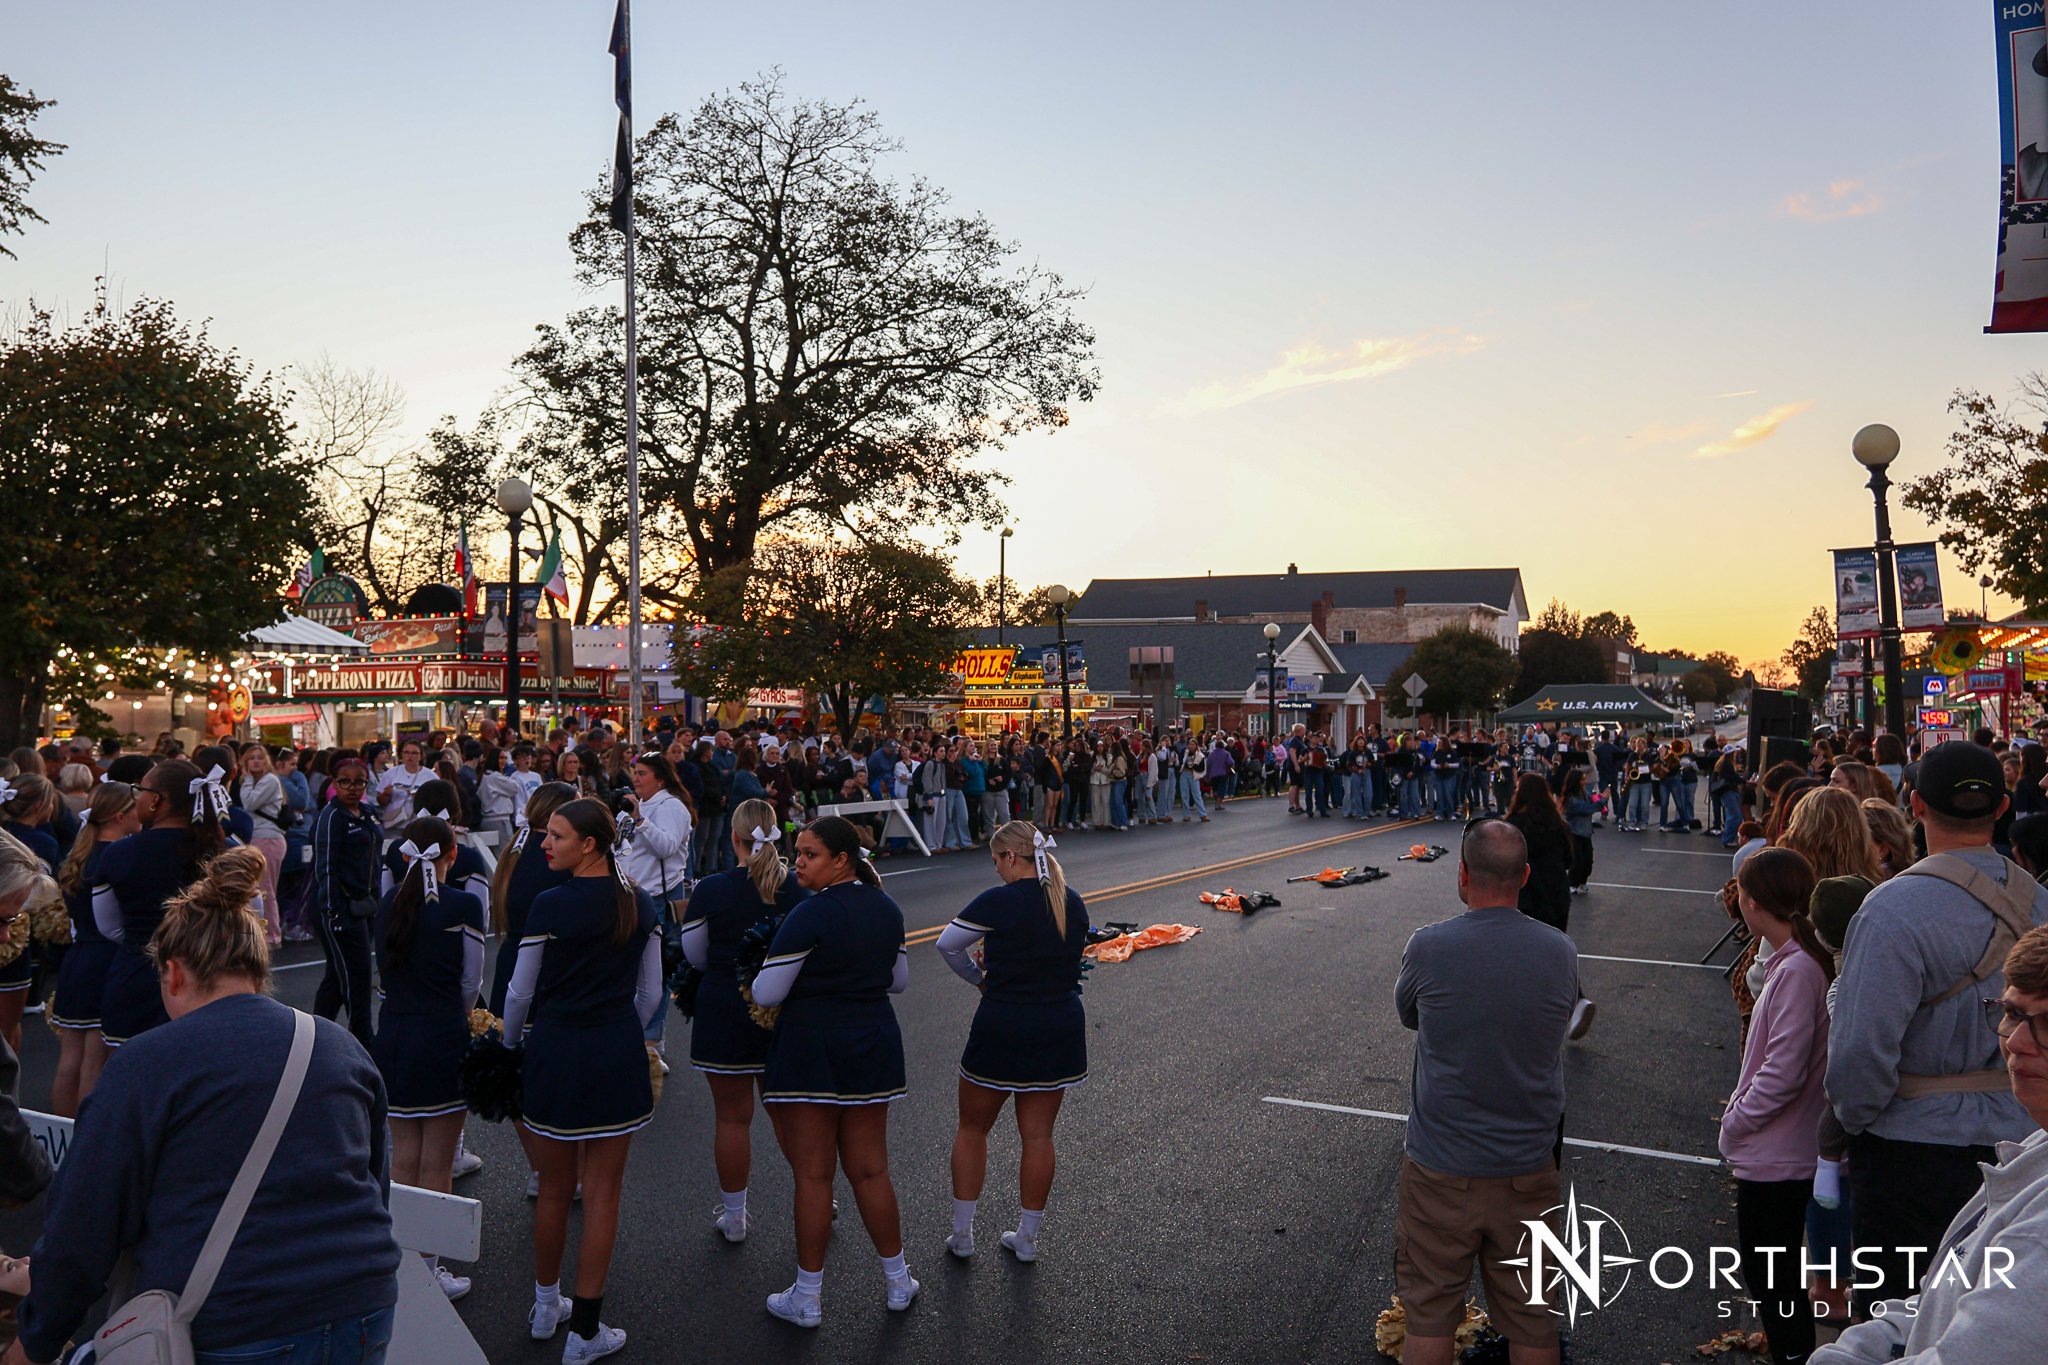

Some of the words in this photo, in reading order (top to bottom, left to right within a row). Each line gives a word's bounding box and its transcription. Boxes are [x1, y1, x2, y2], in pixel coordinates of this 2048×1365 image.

[313, 581, 347, 596] FAMOUS
[307, 607, 353, 627] PIZZA
[957, 655, 1011, 678] ROLLS
[298, 670, 373, 690] PEPPERONI
[375, 670, 415, 689] PIZZA
[425, 669, 451, 689] Cold
[456, 671, 500, 689] Drinks
[520, 677, 538, 688] zza
[540, 676, 551, 691] by
[556, 676, 570, 688] the
[573, 676, 598, 689] Slice!
[760, 689, 786, 703] GYROS
[965, 698, 996, 707] NAMON
[997, 697, 1028, 707] ROLLS
[1562, 701, 1589, 710] U.S.
[1592, 701, 1639, 710] ARMY
[1937, 733, 1950, 743] NO
